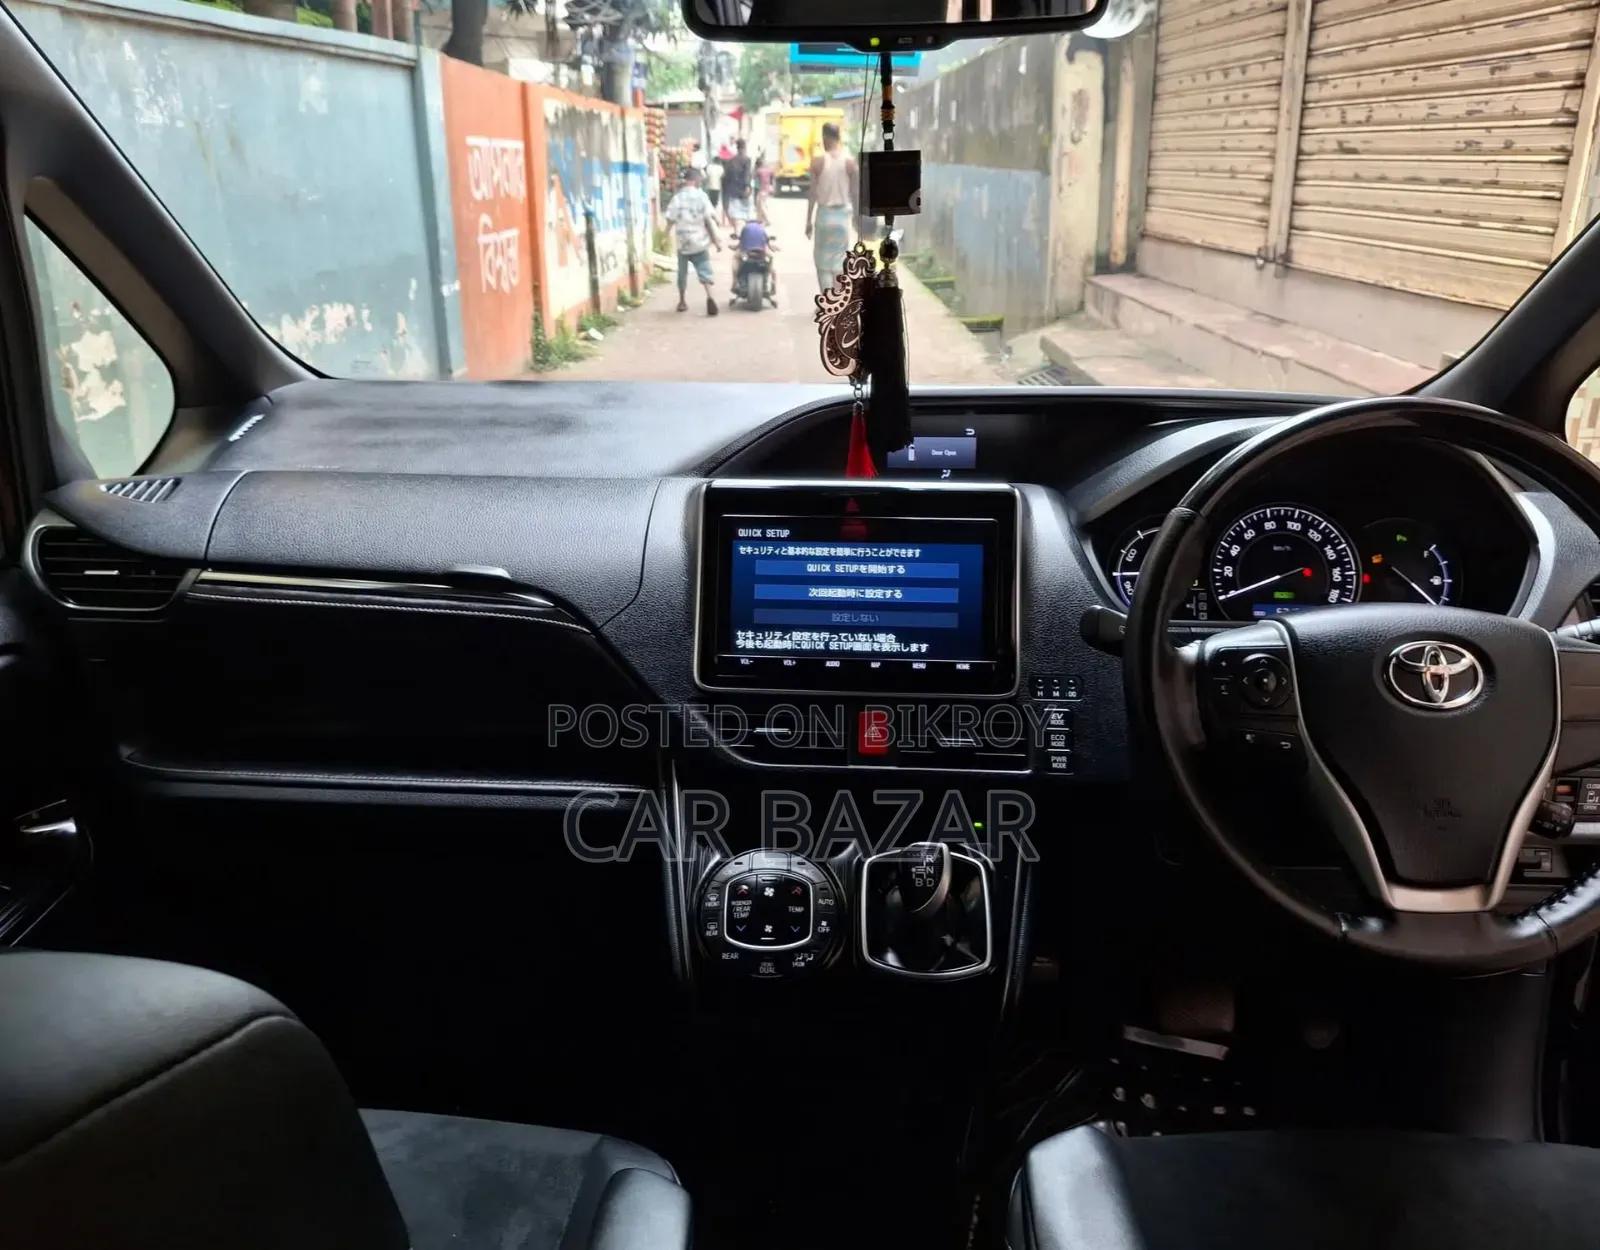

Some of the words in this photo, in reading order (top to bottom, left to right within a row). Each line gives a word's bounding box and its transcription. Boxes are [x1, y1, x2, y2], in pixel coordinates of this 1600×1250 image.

[1264, 521, 1277, 531] 80
[1286, 520, 1302, 532] 100
[738, 528, 762, 538] QUICK
[766, 529, 790, 538] SETUP
[1243, 529, 1256, 540] 60
[1307, 528, 1322, 542] 120
[1125, 548, 1137, 562] ECO
[1230, 544, 1241, 557] 40
[1323, 544, 1337, 560] 140
[806, 563, 831, 573] QUICK
[835, 564, 905, 575] SETUPを開始する
[1223, 566, 1233, 577] 20
[1332, 567, 1342, 582] 160
[808, 588, 903, 600] 次回起動時に設定する
[1327, 588, 1340, 603] 180
[831, 612, 880, 623] 設定しない
[736, 630, 896, 643] セキュリティ設定を行っていない場合
[926, 855, 934, 863] R
[926, 866, 934, 874] N
[915, 878, 924, 887] B
[926, 878, 935, 887] D
[722, 952, 739, 960] REAR
